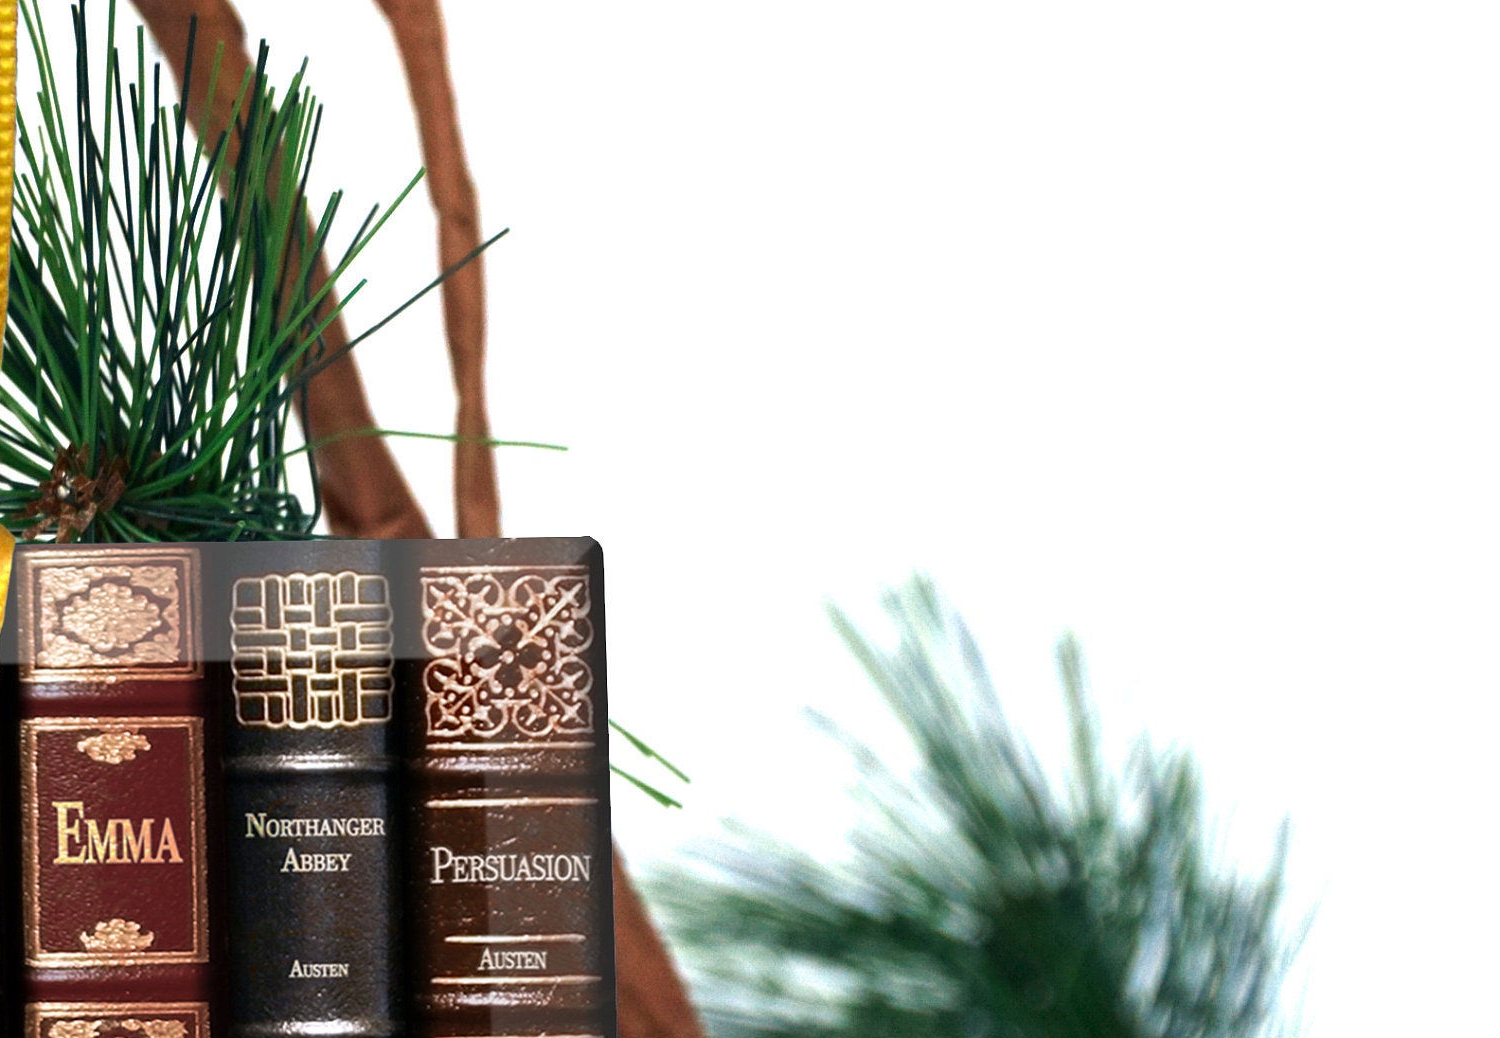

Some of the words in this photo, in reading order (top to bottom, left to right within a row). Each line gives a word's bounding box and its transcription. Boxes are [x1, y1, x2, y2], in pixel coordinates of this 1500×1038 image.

[51, 801, 184, 865] EMMA
[245, 812, 386, 840] NORTHANGER
[280, 849, 351, 875] ABBEY
[430, 847, 591, 885] PERSUASION
[289, 959, 349, 979] AUSTEN
[478, 947, 547, 971] AUSTEN
